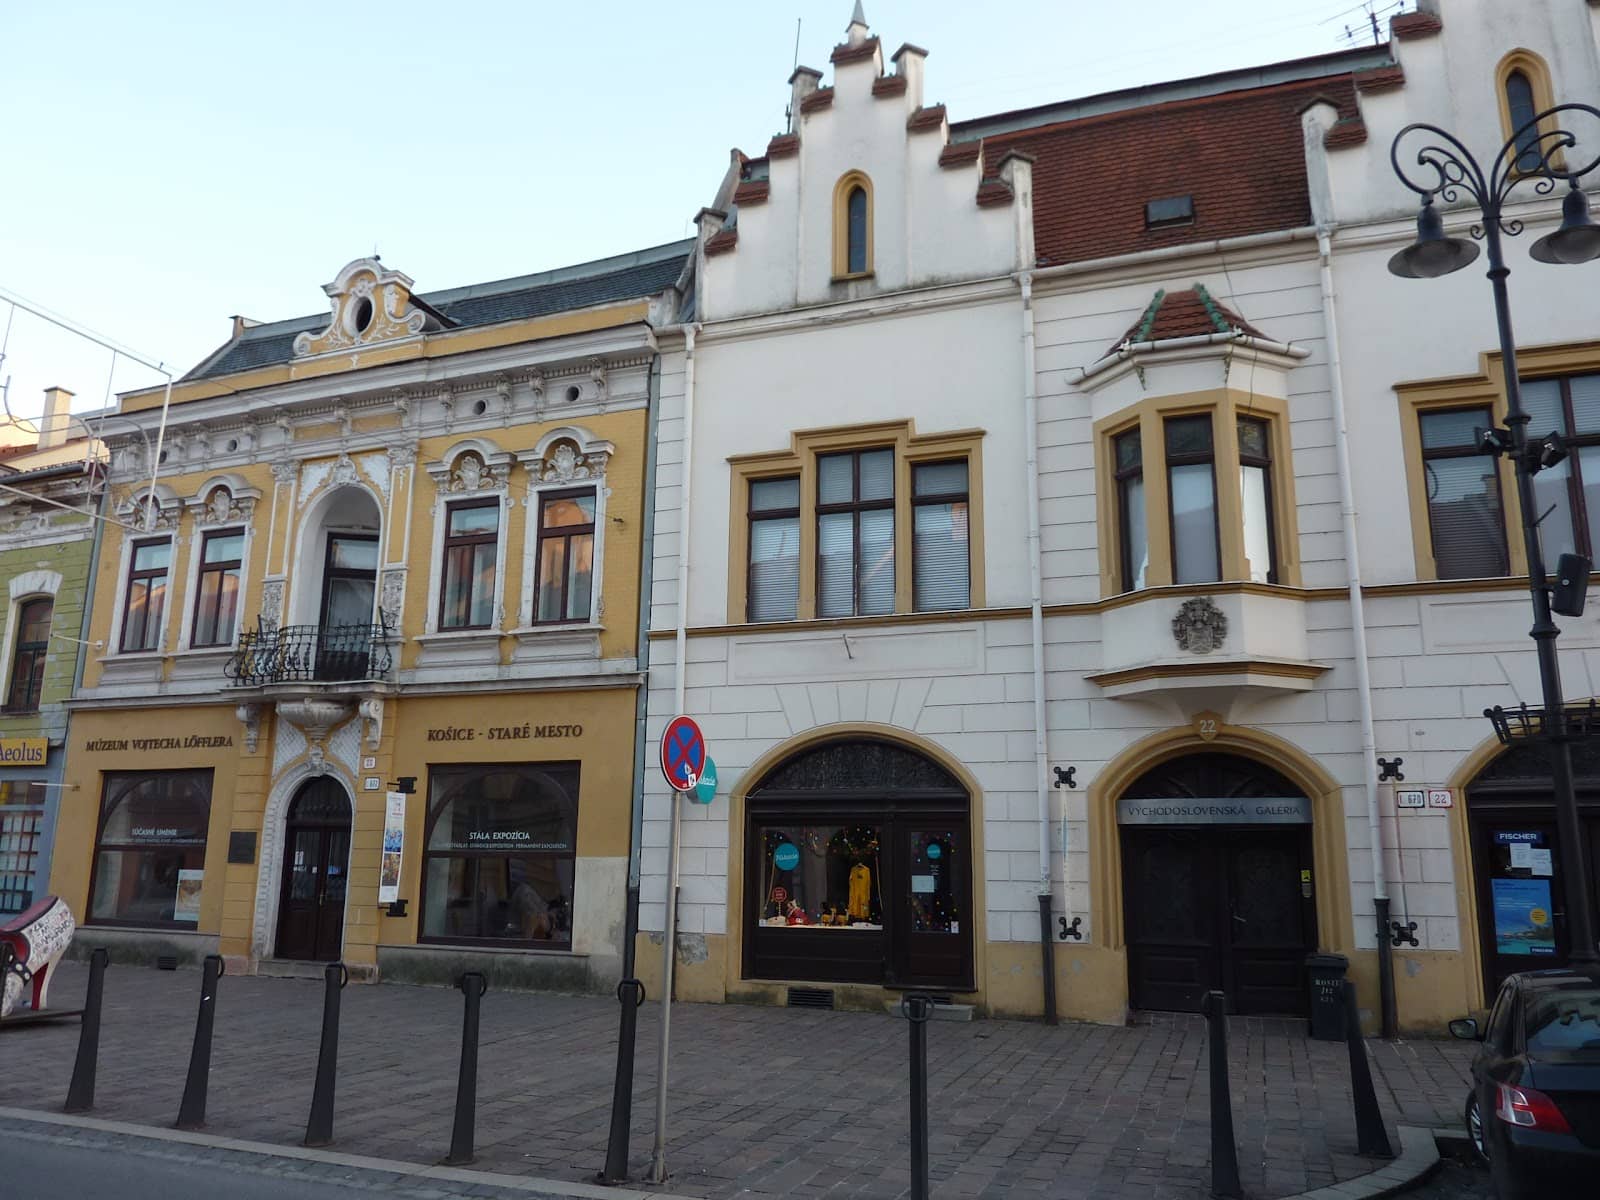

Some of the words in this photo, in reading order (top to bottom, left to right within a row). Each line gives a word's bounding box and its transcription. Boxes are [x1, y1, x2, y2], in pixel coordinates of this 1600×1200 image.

[427, 726, 475, 741] KOŠICE
[487, 723, 531, 740] STARÉ
[534, 724, 583, 738] MESTO
[1200, 719, 1216, 733] 22
[86, 738, 128, 752] MÚZEUM
[132, 737, 181, 751] VOJTECHA
[1434, 793, 1447, 804] 22
[492, 831, 530, 840] EXPOZÍCIA
